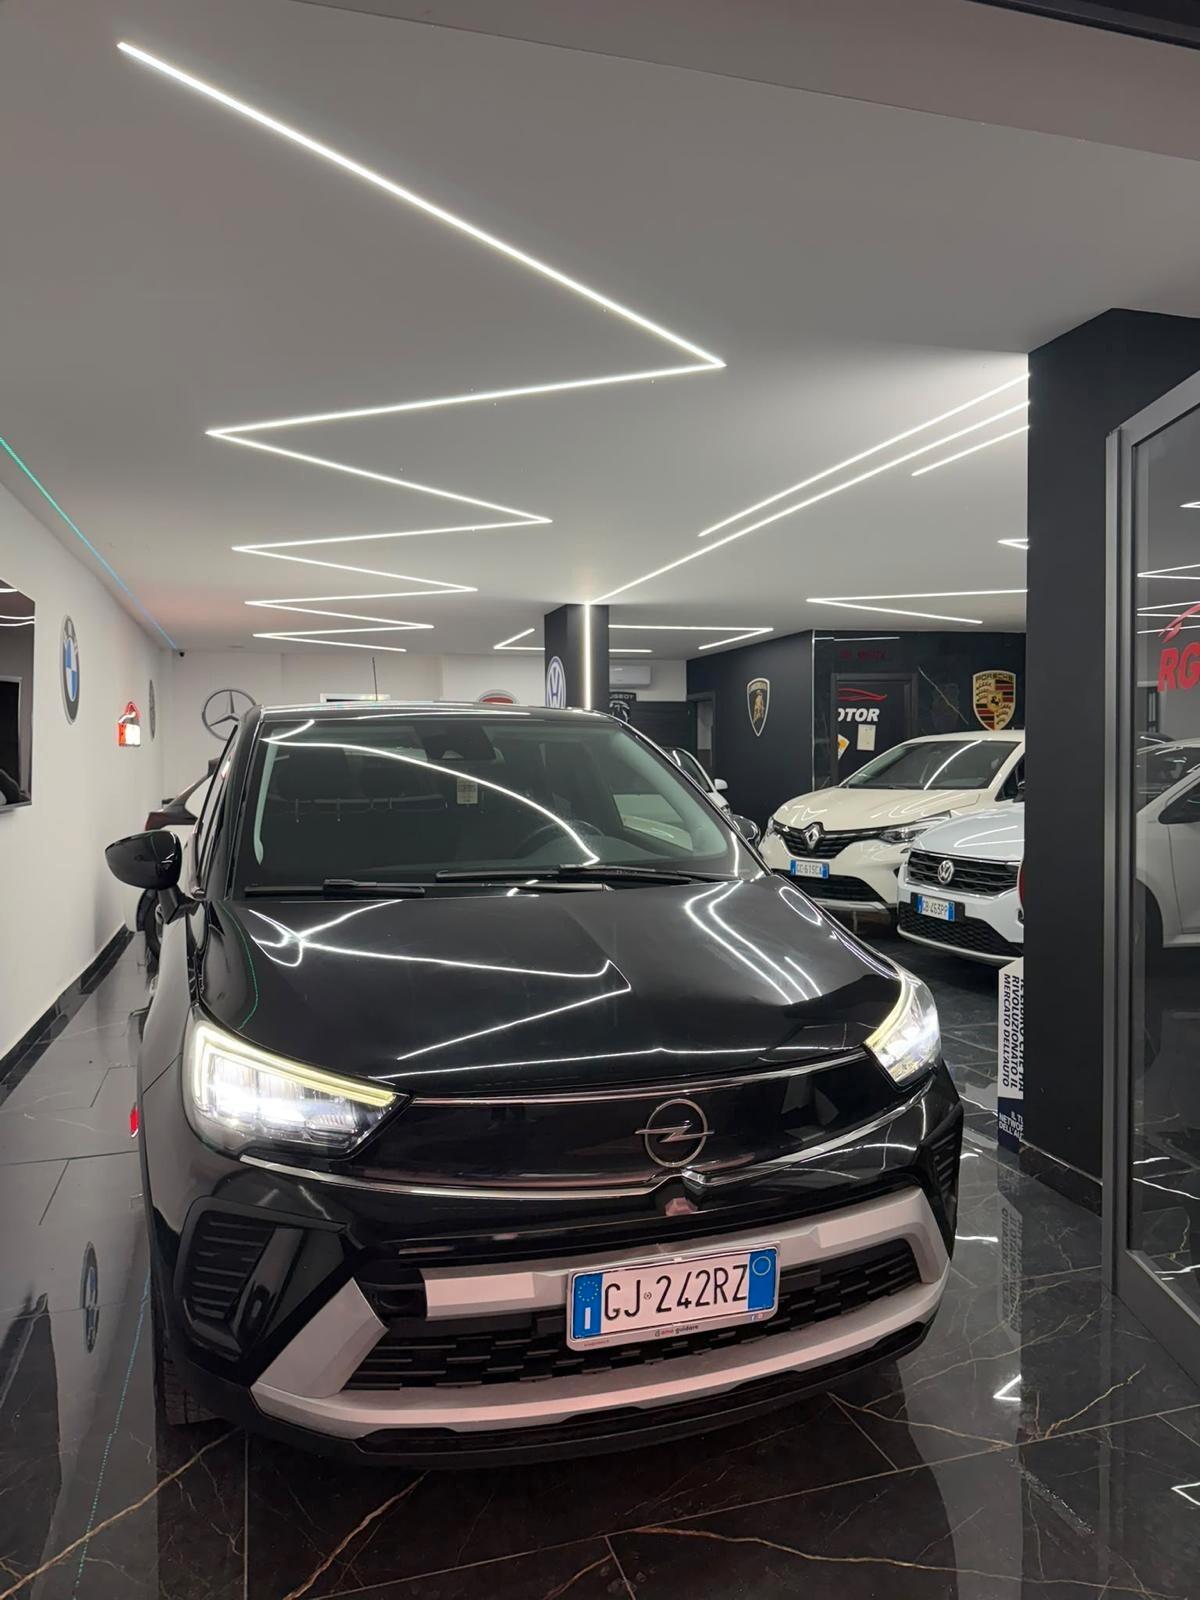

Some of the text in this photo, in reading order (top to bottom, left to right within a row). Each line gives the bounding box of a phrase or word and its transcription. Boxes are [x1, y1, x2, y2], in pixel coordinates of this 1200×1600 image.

[1157, 642, 1200, 693] RG
[1002, 973, 1011, 1088] MERCATO DELL'AUTO
[1010, 975, 1020, 1089] RIVOLUZIONATO IL
